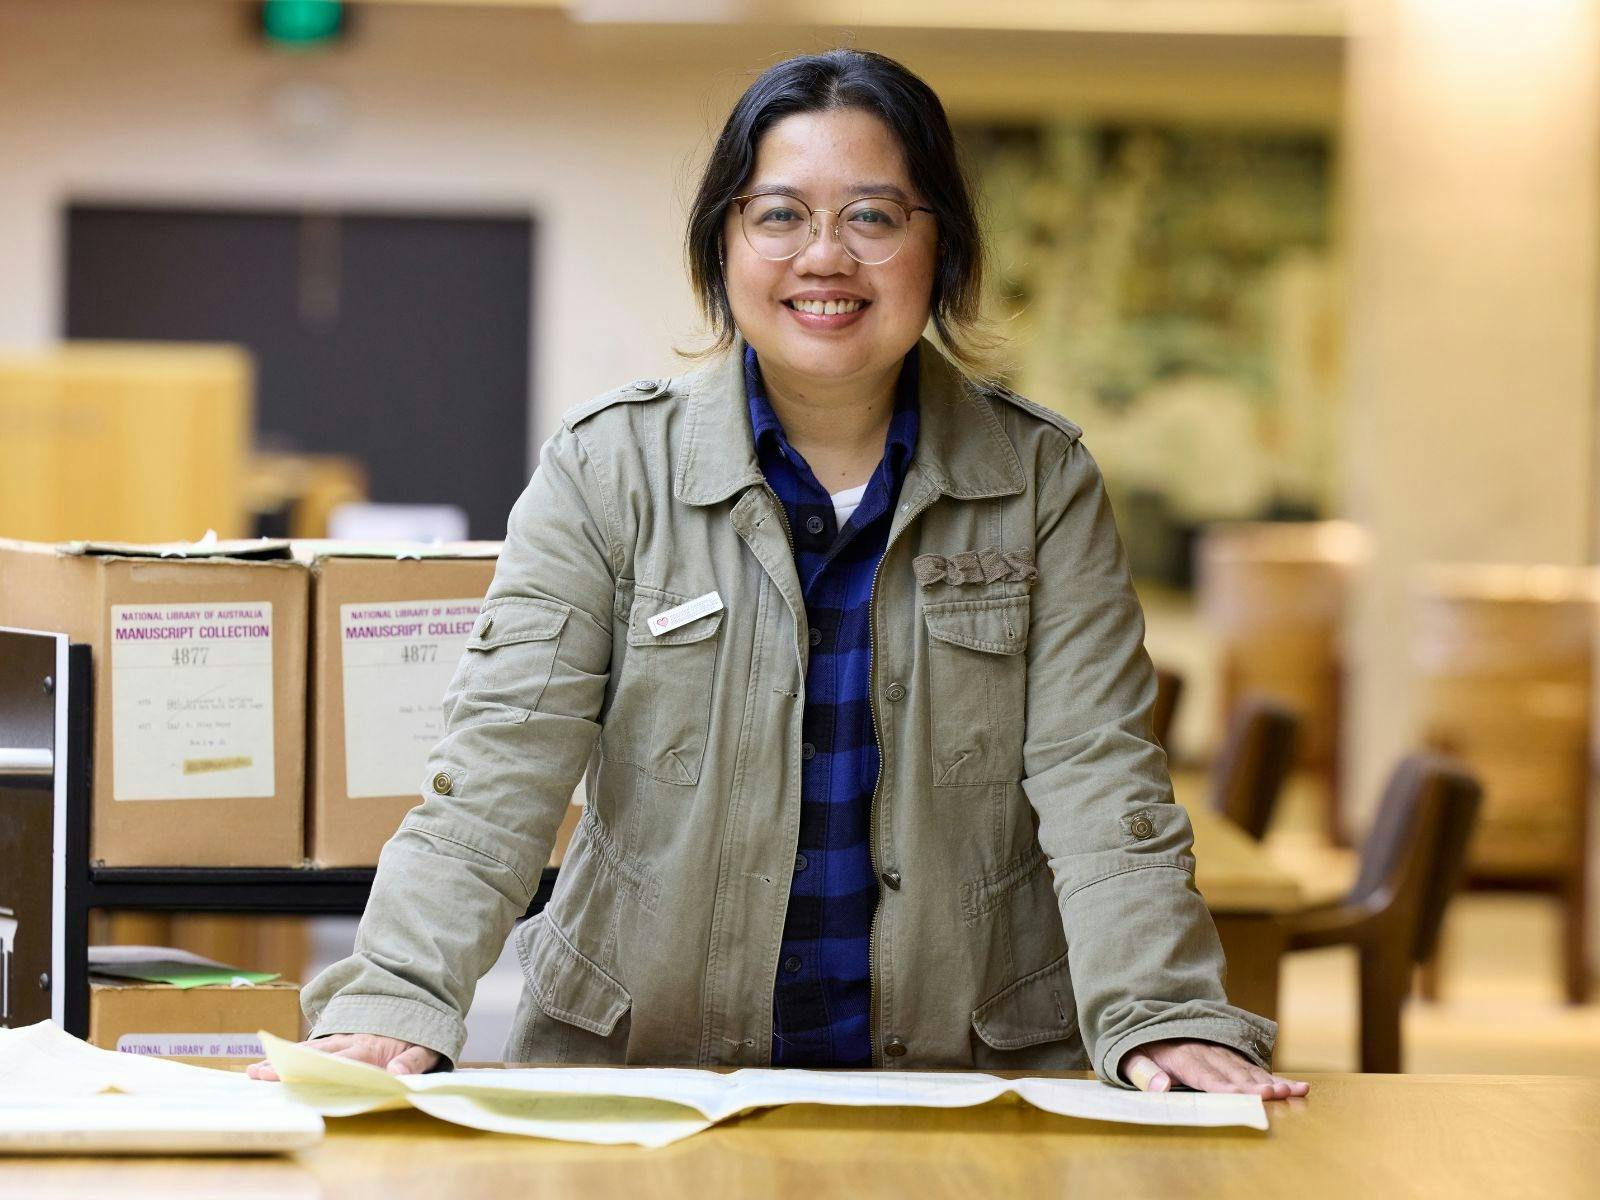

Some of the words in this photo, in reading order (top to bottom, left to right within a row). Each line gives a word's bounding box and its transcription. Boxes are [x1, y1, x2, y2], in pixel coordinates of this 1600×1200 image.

[121, 611, 163, 620] NATIONAL
[166, 609, 200, 619] LIBRARY
[204, 610, 214, 619] OF
[217, 609, 263, 618] AUSTRALIA
[351, 609, 391, 619] NATIONAL
[395, 608, 429, 617] LIBRARY
[433, 607, 442, 616] OF
[115, 627, 194, 640] MANUSCRIPT
[199, 625, 269, 638] COLLECTION
[345, 623, 423, 638] MANUSCRIPT
[171, 647, 209, 666] 4877
[400, 644, 438, 663] 4877
[121, 1045, 163, 1055] NATIONAL
[169, 1044, 204, 1055] LIBRARY
[210, 1044, 220, 1055] OF
